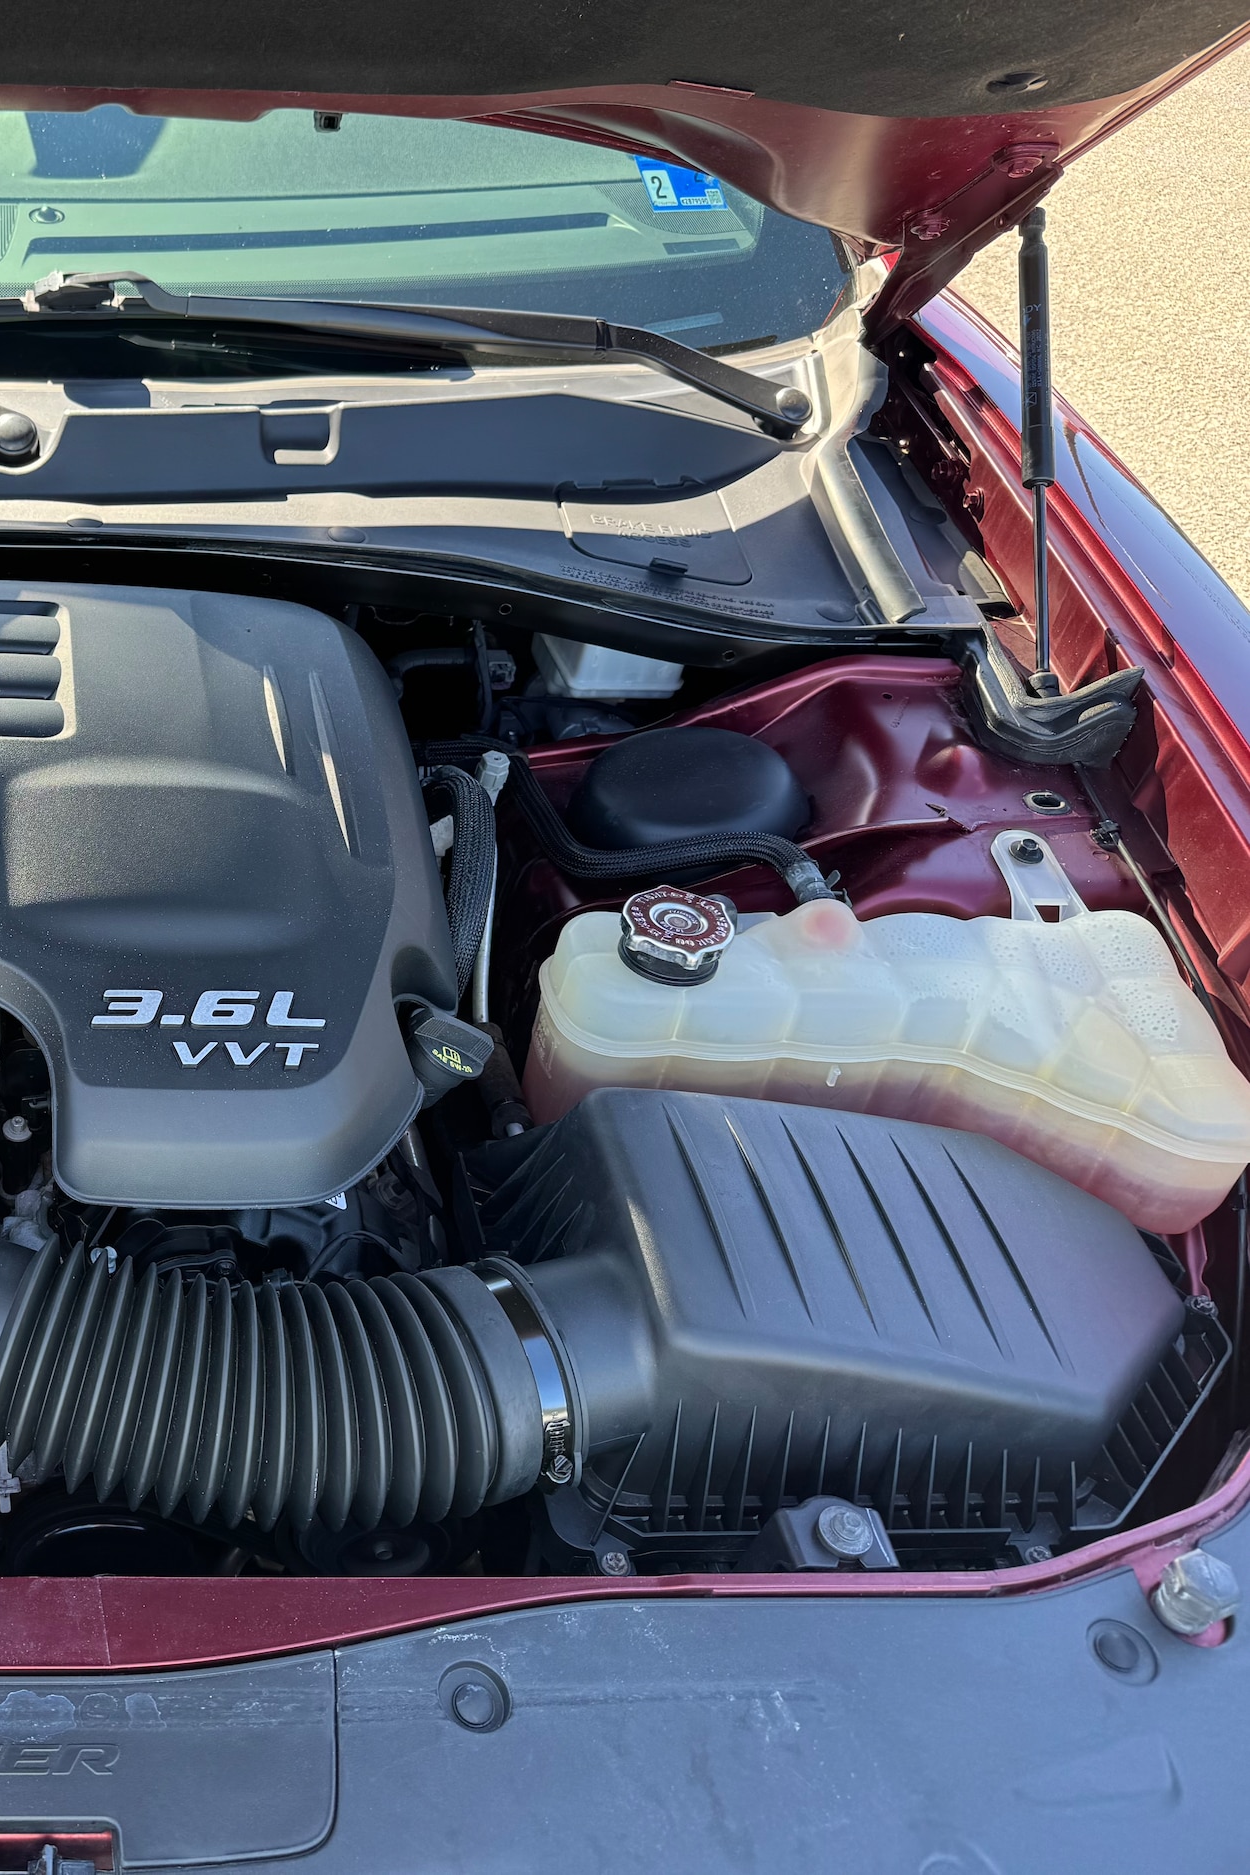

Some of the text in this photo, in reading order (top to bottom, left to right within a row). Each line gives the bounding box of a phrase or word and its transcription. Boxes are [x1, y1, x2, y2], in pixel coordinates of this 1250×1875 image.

[650, 175, 668, 200] 2
[590, 513, 712, 540] BRAKE FLUID
[617, 529, 693, 549] ACCESS
[91, 989, 327, 1030] 3.6L
[171, 1041, 320, 1070] VVT
[431, 1048, 473, 1073] SAE 5W-20
